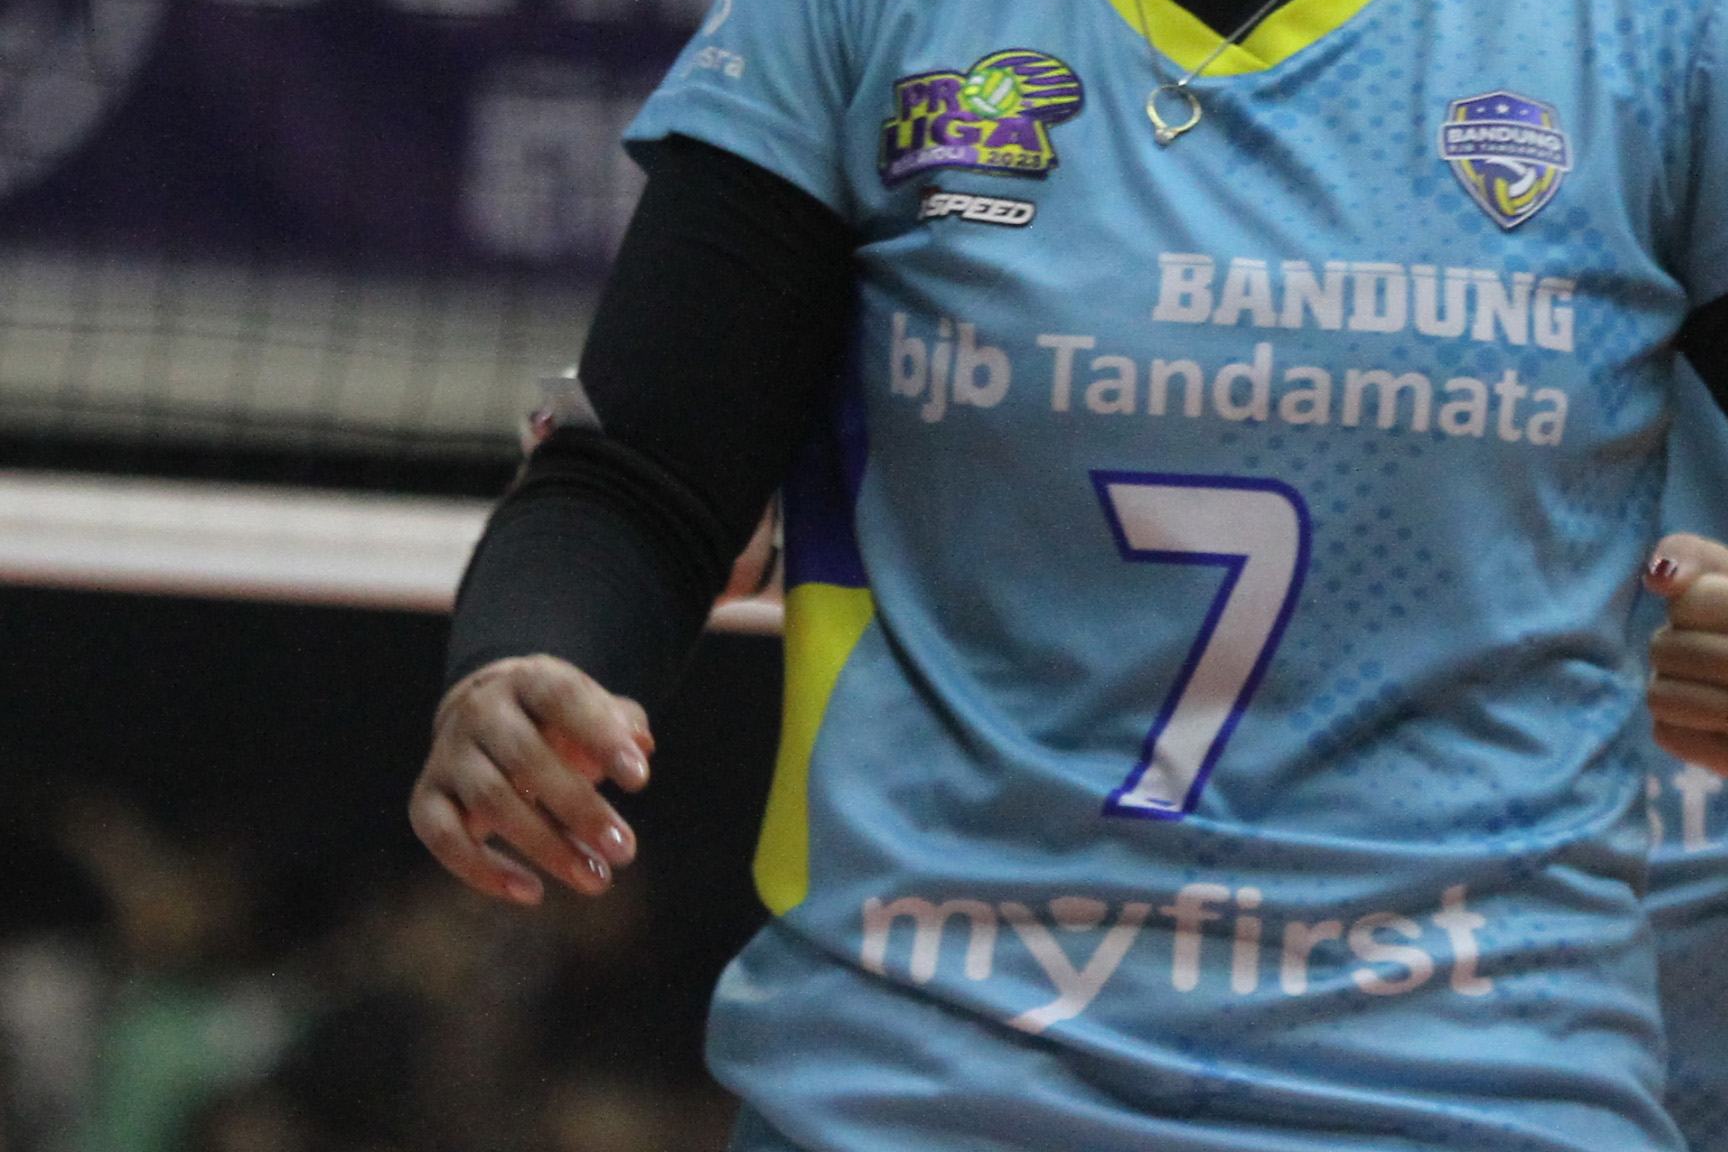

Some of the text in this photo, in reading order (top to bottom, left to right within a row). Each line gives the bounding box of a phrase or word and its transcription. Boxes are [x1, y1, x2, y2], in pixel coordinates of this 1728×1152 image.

[1446, 127, 1562, 152] BANDUNG
[1152, 252, 1575, 352] BANDUNG
[889, 313, 1570, 446] bjb Tandamata
[1089, 470, 1312, 820] 7
[860, 883, 1495, 1033] myfirst
